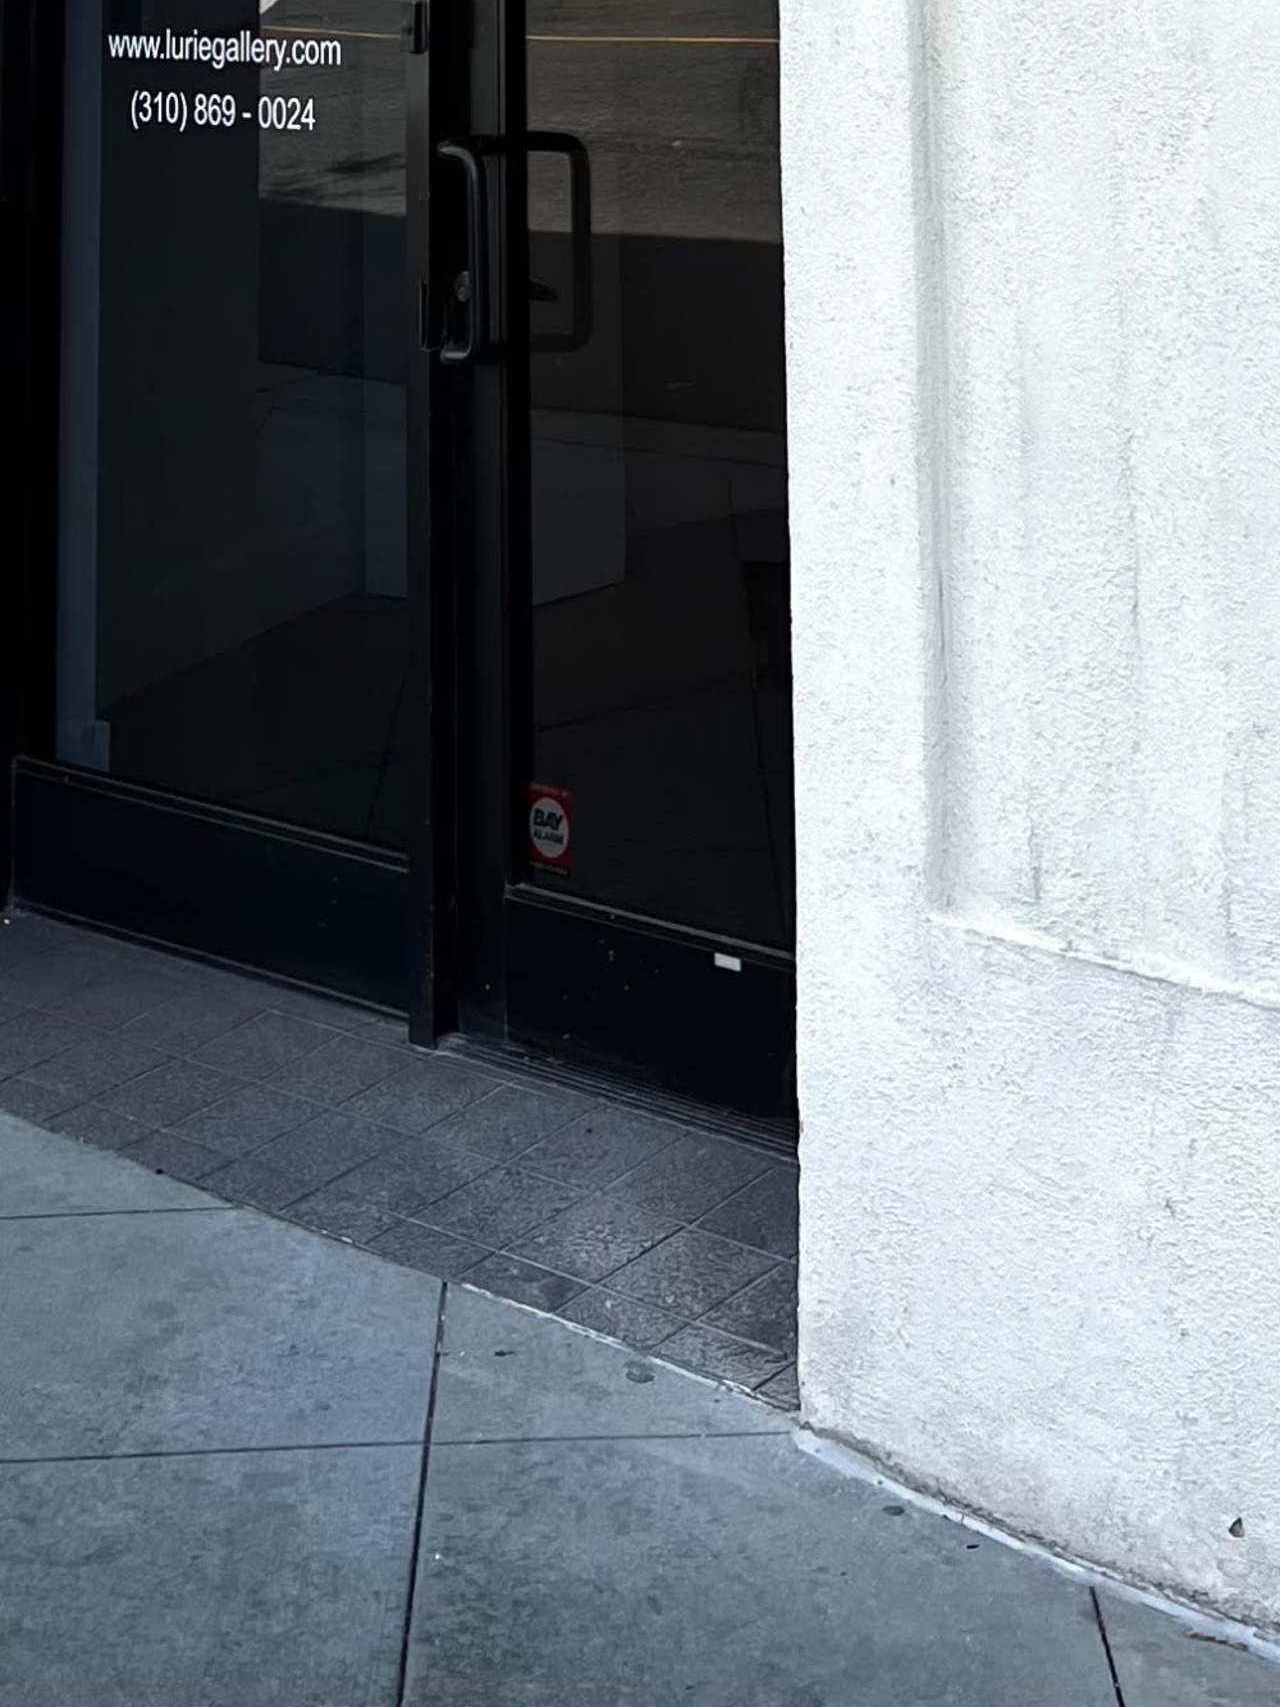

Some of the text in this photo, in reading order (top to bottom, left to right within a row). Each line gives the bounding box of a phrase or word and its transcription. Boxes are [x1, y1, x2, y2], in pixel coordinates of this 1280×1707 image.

[107, 27, 343, 73] www.luriegallery.com
[129, 89, 189, 133] (310)
[192, 92, 237, 128] 869
[257, 95, 317, 132] 0024
[533, 807, 563, 831] BAY
